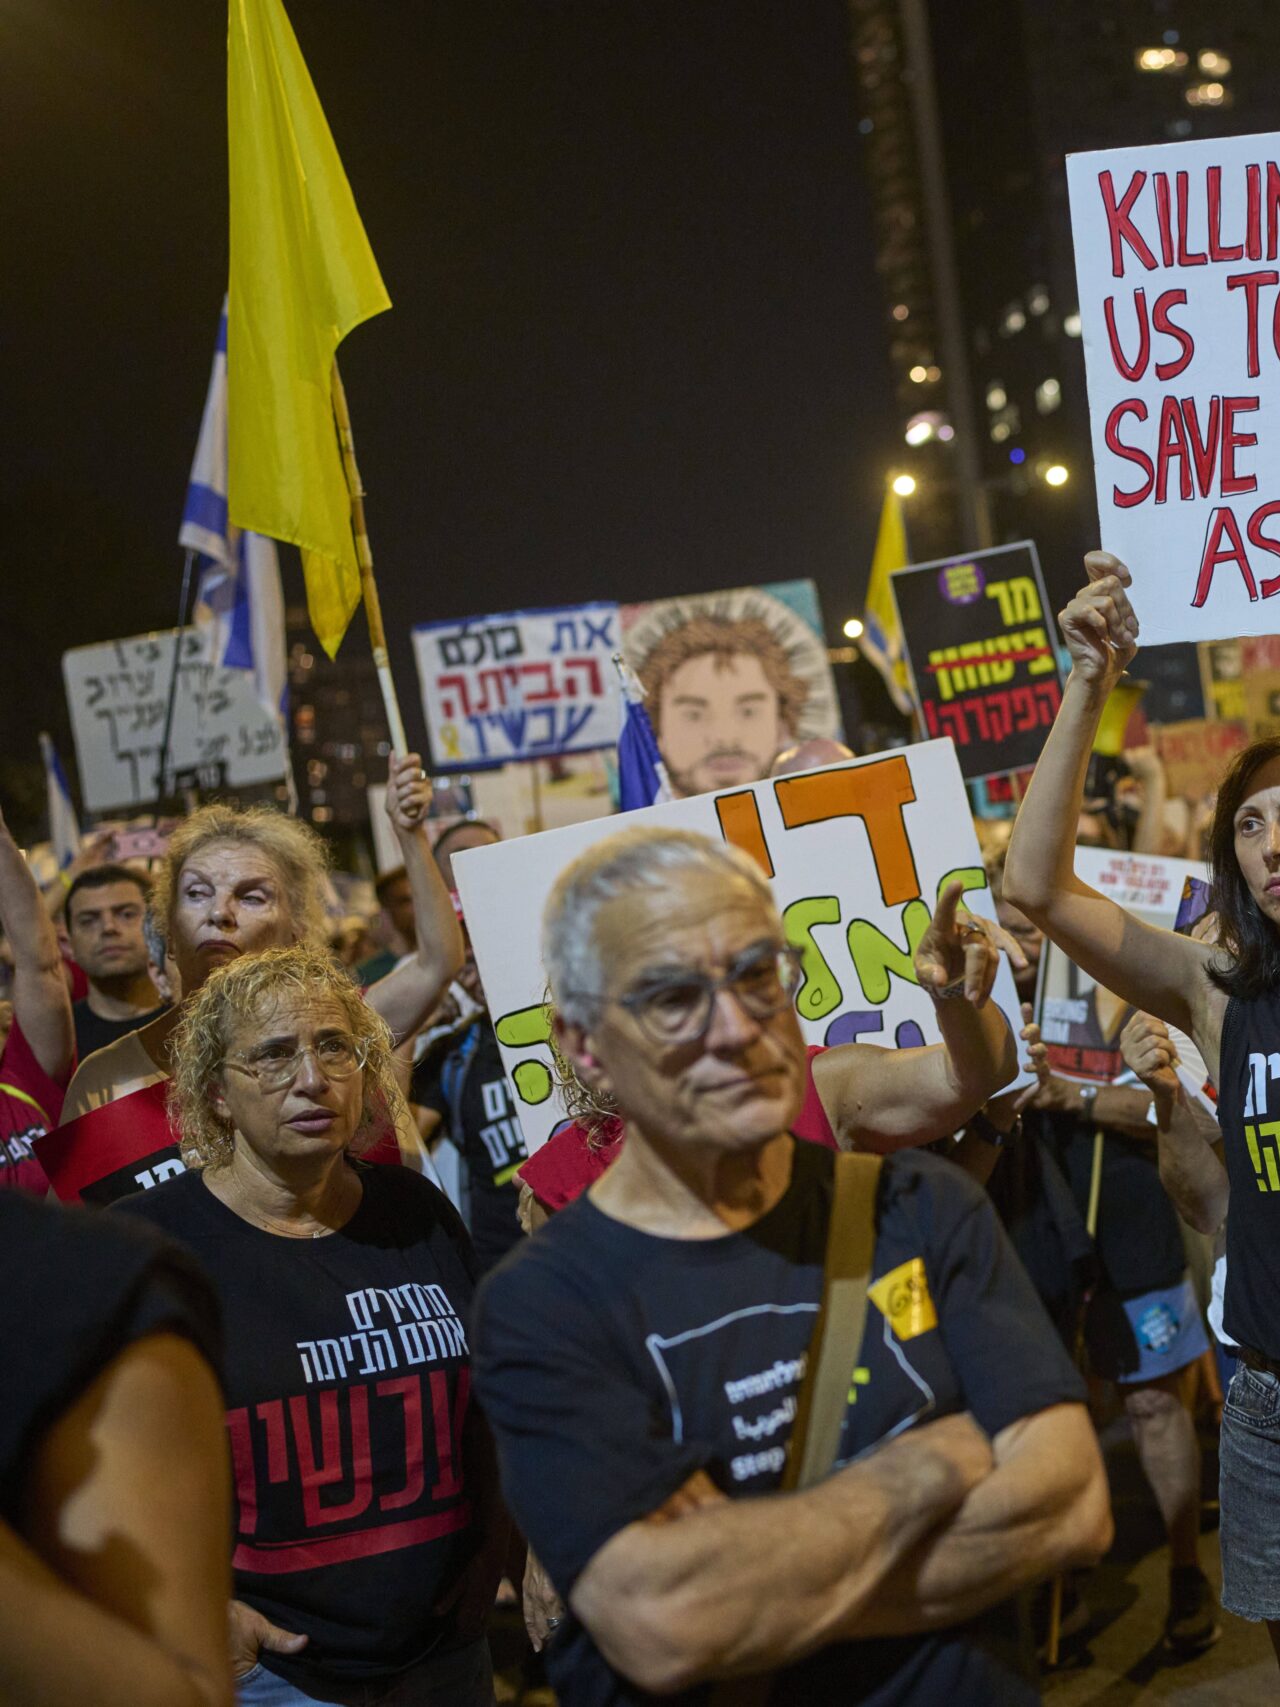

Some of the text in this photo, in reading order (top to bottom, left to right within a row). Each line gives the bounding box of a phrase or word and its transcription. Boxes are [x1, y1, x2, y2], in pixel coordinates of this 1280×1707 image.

[1103, 288, 1195, 382] US
[1104, 395, 1260, 508] SAVE
[985, 576, 1042, 626] מר
[550, 616, 614, 652] את
[928, 627, 1056, 700] ביטחון
[437, 657, 604, 719] הביתה
[923, 680, 1064, 745] הפקרה!
[467, 705, 594, 757] עכשיו
[714, 755, 917, 907] די
[345, 1283, 456, 1331] מחזירים
[296, 1317, 470, 1383] אותם הביתה
[225, 1365, 471, 1534] עכשיו
